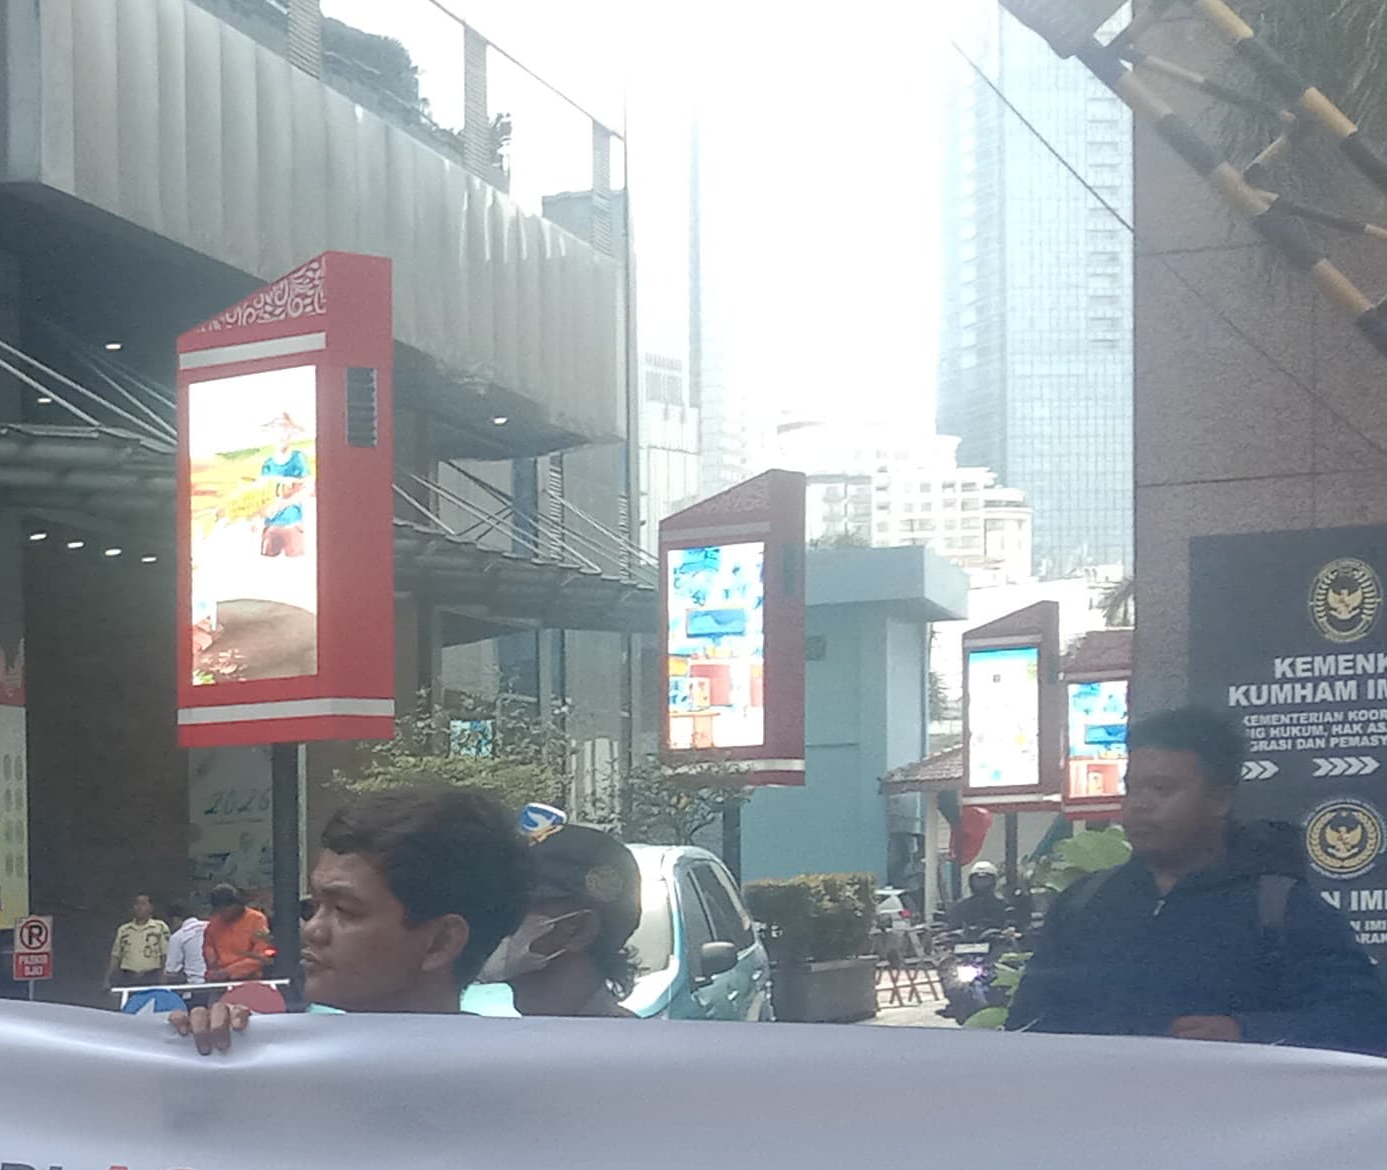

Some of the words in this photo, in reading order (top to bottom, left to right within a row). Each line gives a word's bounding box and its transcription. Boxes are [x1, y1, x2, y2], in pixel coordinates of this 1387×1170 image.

[1228, 680, 1357, 706] KUMHAM
[1332, 723, 1363, 735] HAK
[1296, 737, 1325, 749] DAN
